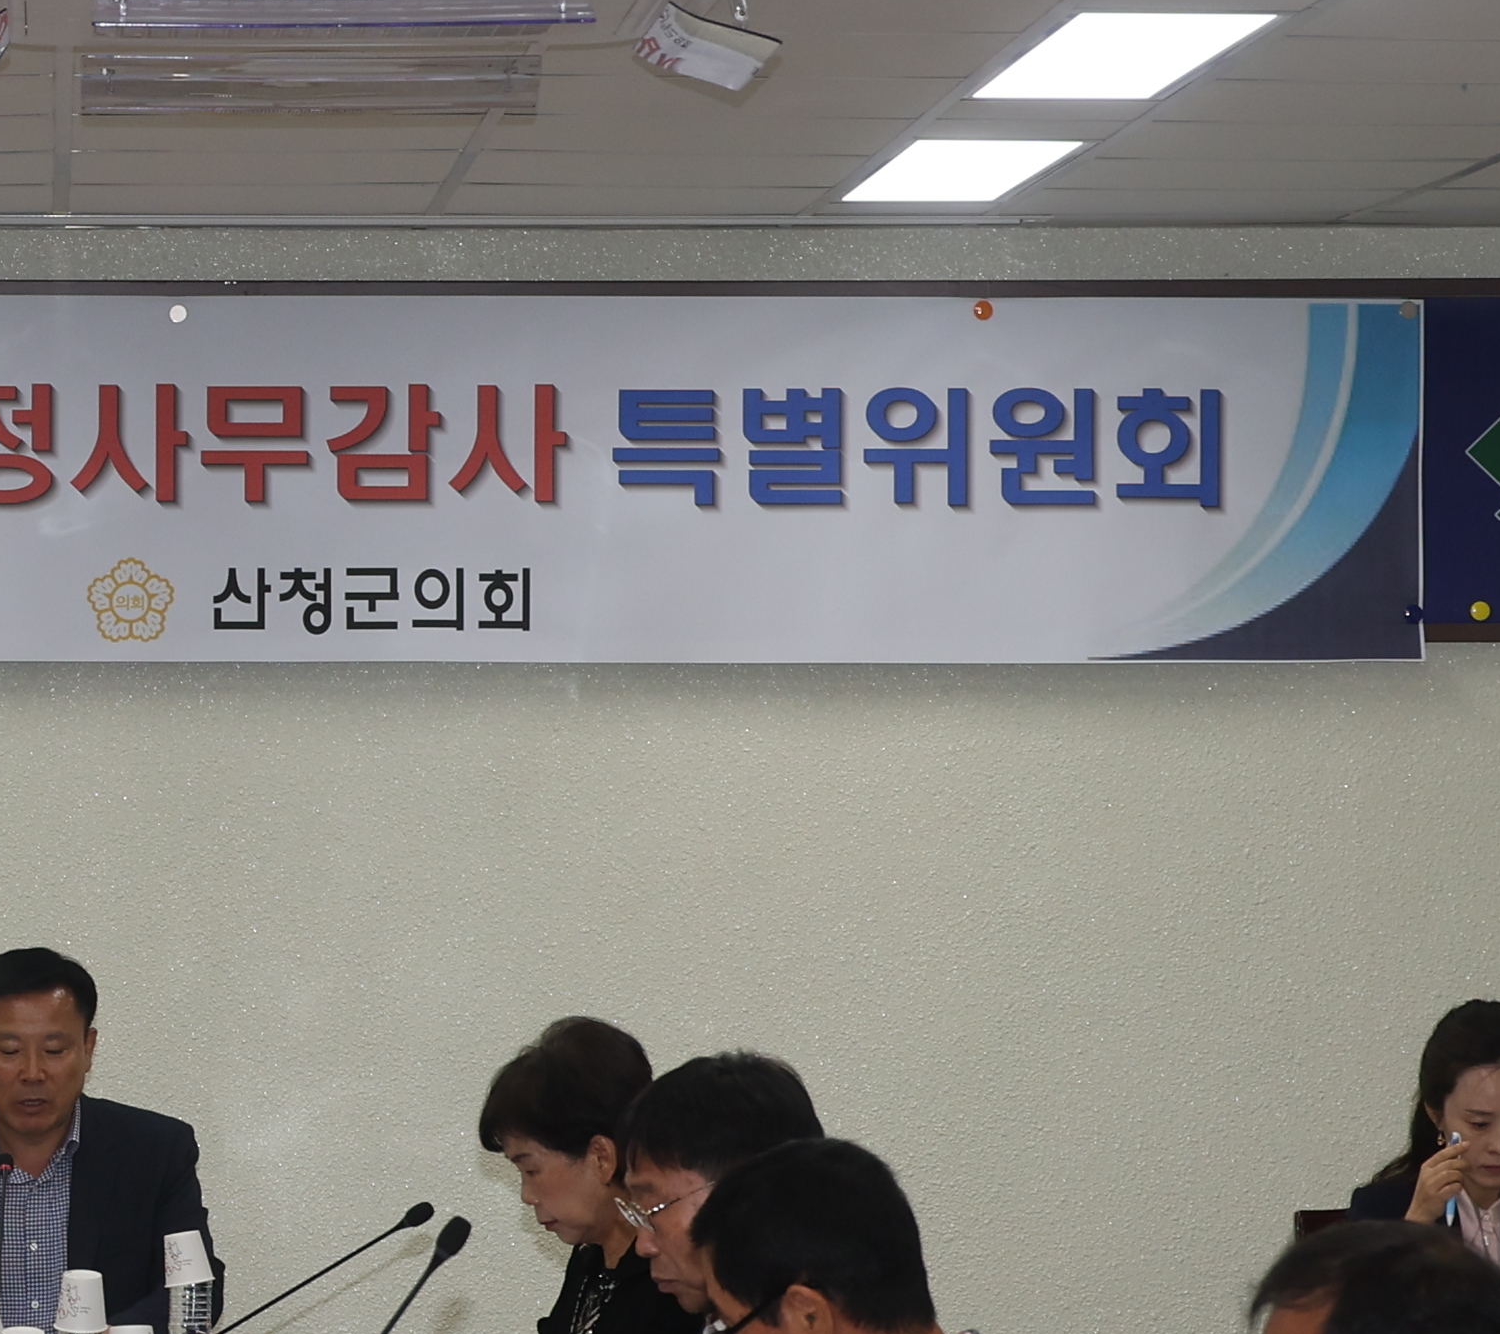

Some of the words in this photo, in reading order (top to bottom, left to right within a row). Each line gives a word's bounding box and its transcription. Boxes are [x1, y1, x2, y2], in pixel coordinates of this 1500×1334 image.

[612, 387, 1222, 508] 특별위원회
[115, 594, 145, 611] 의회
[212, 566, 532, 635] 산청군의회
